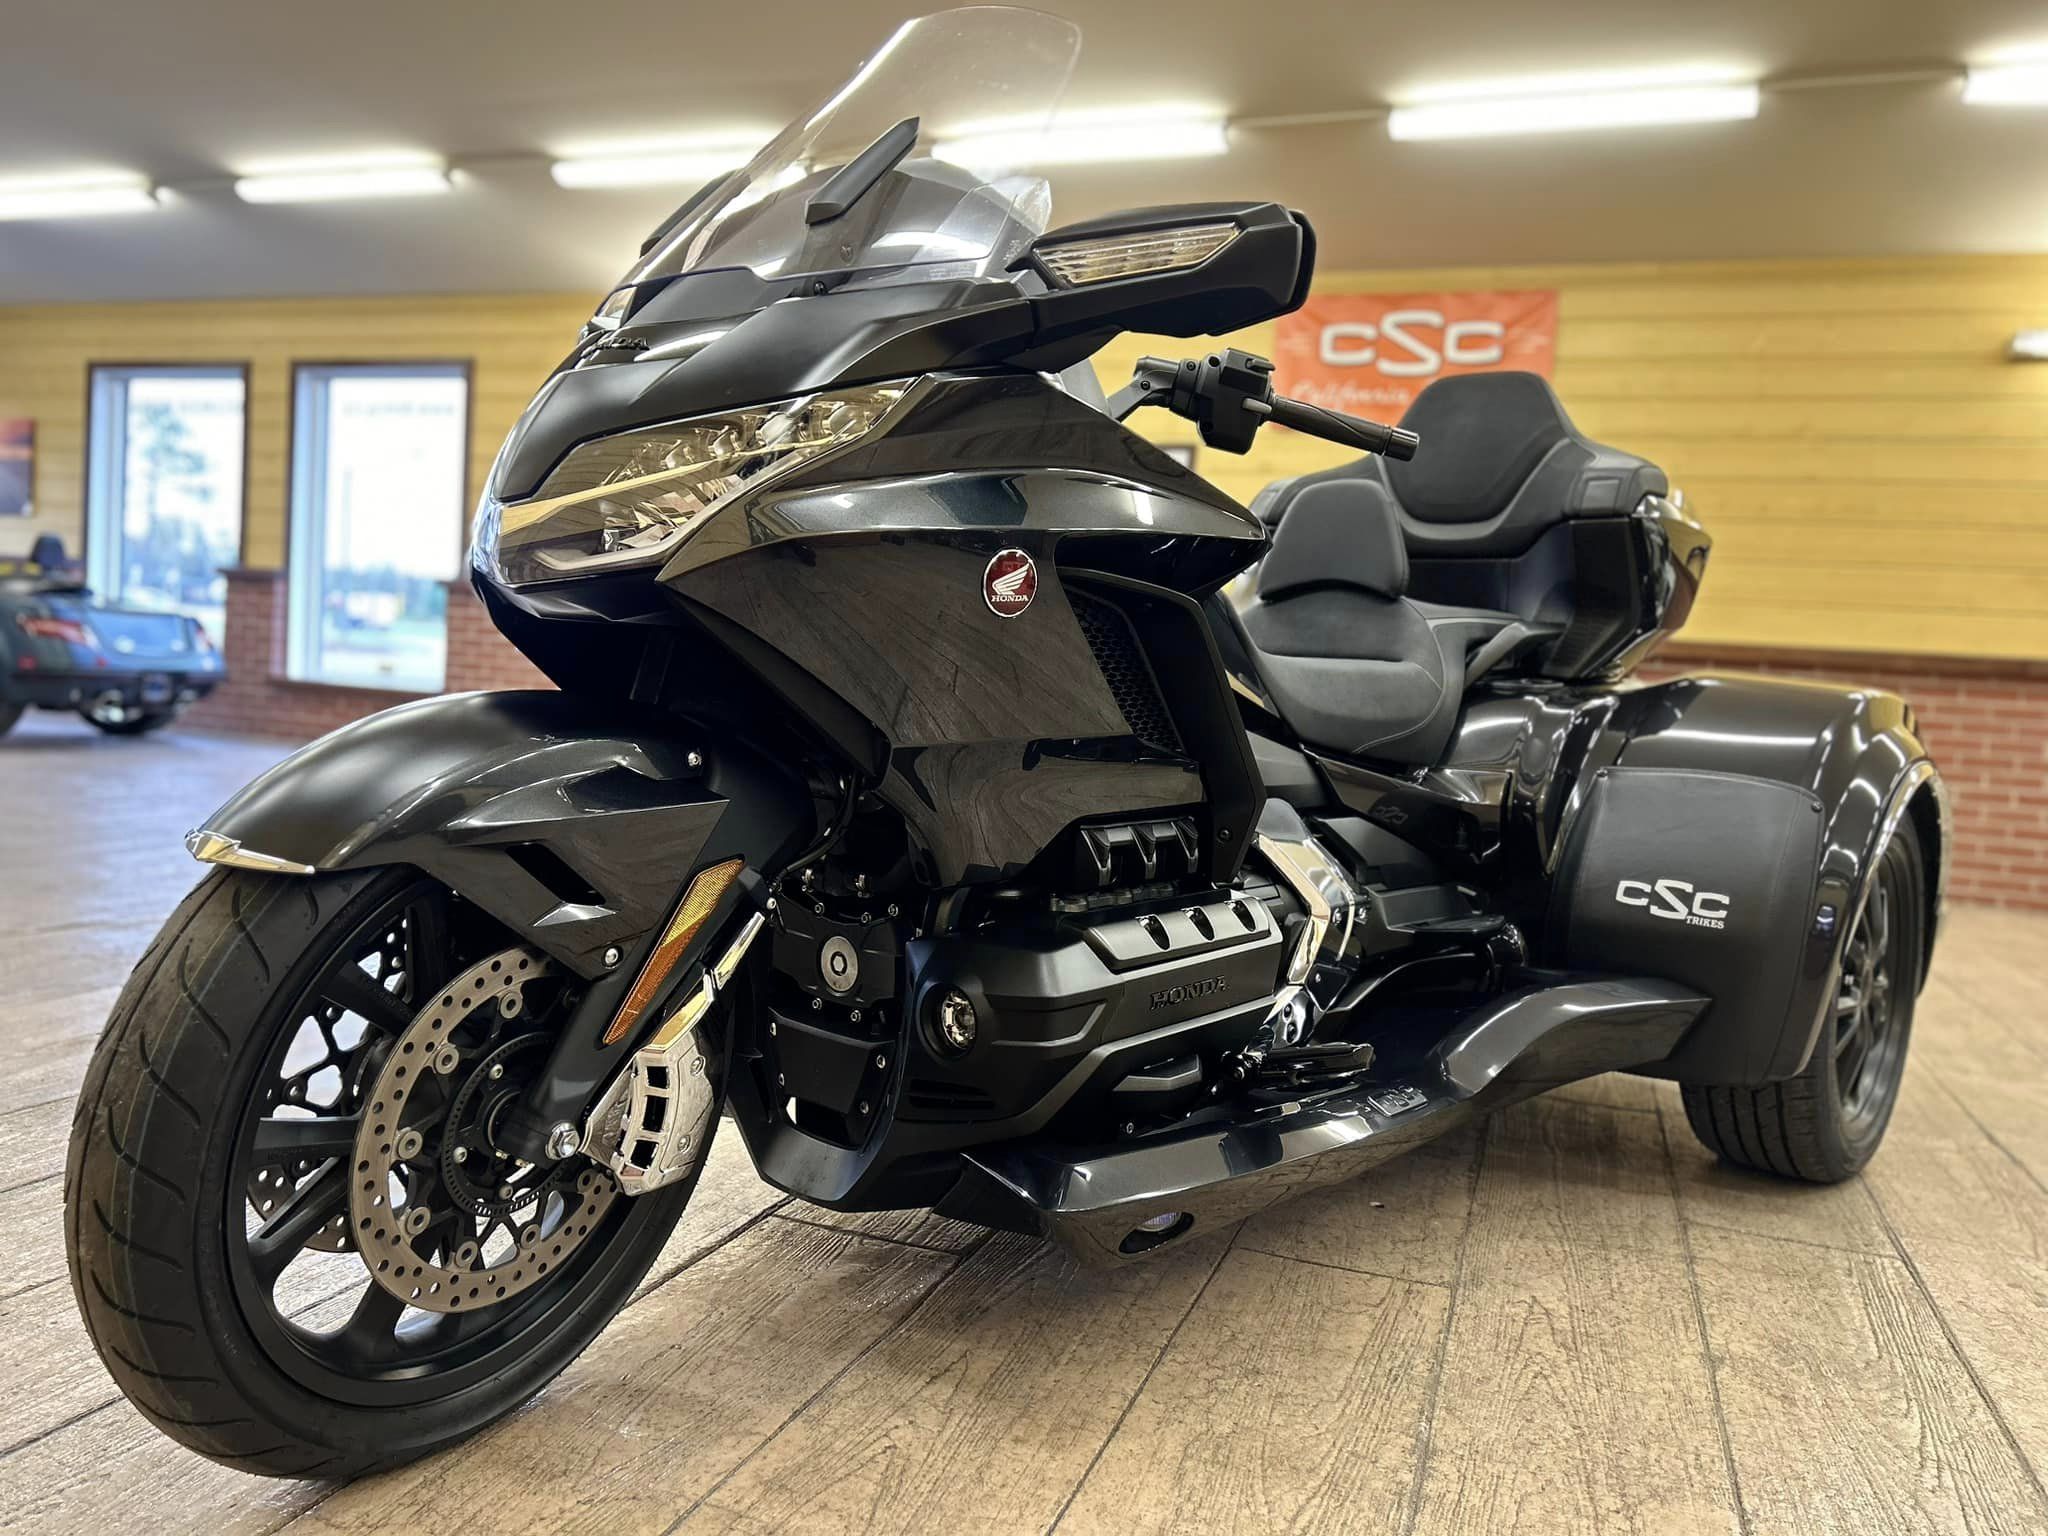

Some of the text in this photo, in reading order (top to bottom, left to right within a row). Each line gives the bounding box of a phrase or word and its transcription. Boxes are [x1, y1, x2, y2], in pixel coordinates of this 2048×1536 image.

[990, 594, 1029, 602] HONDA
[1685, 915, 1725, 929] TRIKES
[1151, 975, 1230, 1010] HONDA
